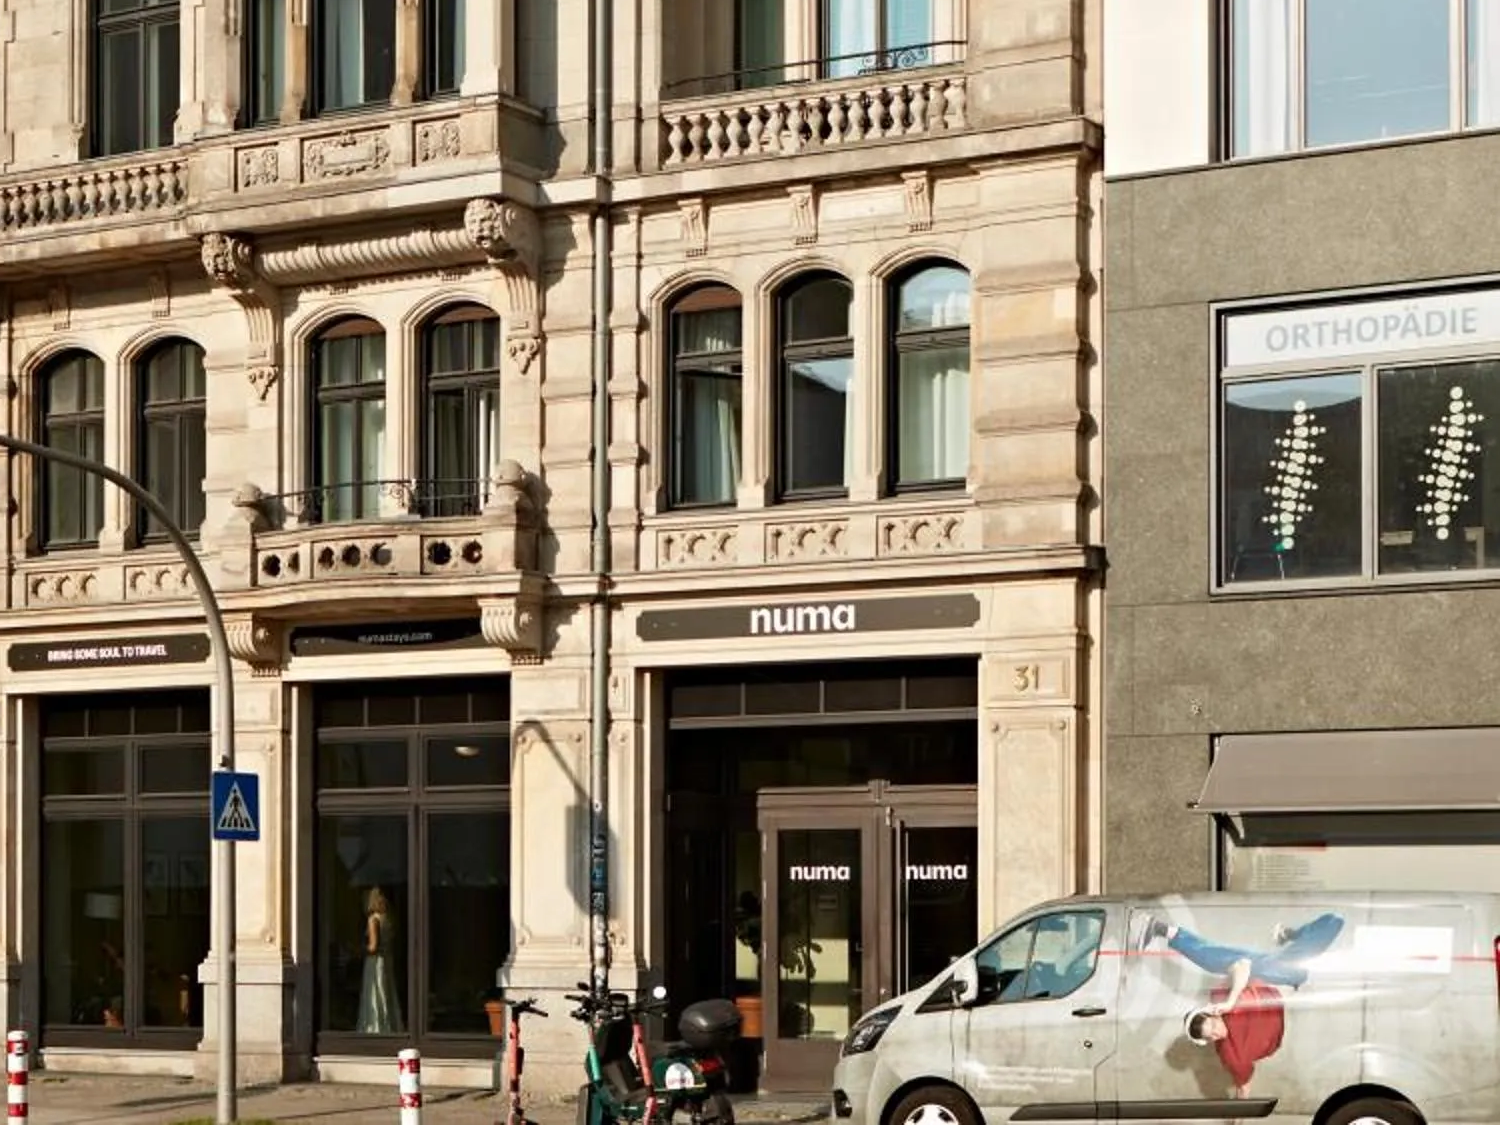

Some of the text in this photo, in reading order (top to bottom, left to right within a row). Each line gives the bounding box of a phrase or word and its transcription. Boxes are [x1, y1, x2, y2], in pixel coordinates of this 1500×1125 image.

[1265, 304, 1478, 353] ORTHOPÄDIE
[750, 603, 856, 634] numa
[74, 648, 98, 660] SOME
[99, 646, 121, 658] SOUL
[122, 645, 134, 657] TO
[135, 644, 167, 656] TRAVEL
[1013, 665, 1039, 693] 31
[790, 865, 851, 881] numa
[905, 864, 967, 880] numa
